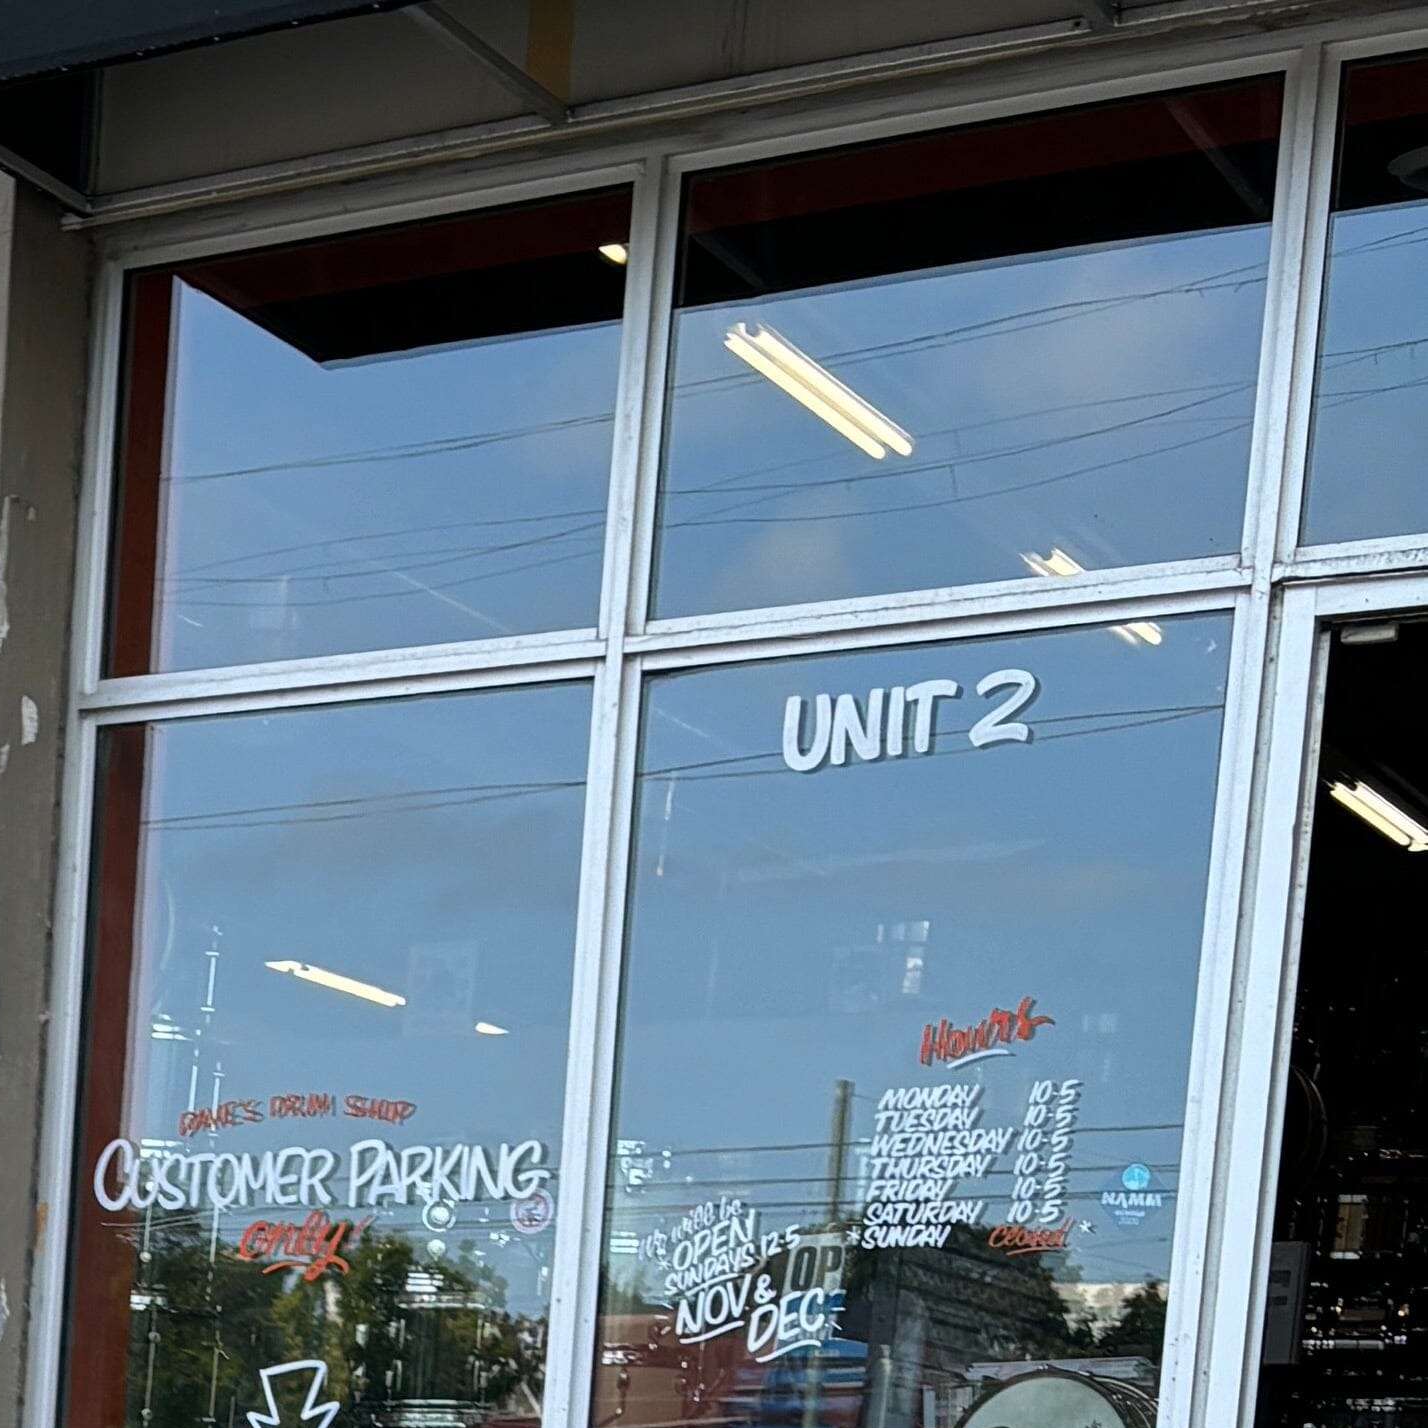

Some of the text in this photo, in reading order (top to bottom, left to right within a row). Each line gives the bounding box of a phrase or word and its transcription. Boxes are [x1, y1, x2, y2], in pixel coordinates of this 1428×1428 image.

[783, 669, 1036, 771] UNIT 2
[878, 1080, 1082, 1110] MONDAY 10-5
[874, 1105, 1077, 1132] TUESDAY 10-5
[870, 1127, 1074, 1157] WEDNESDAY 10-5
[93, 1138, 552, 1212] CUSTOMER PARKING
[869, 1153, 1070, 1180] THURSDAY 10-5
[865, 1177, 1068, 1202] FRIDAY 10-5
[862, 1200, 1064, 1225] SATURDAY 10-5
[672, 1208, 756, 1271] OPEN
[860, 1226, 952, 1249] SUNDAY
[664, 1243, 755, 1296] SUNDAYS
[754, 1274, 777, 1304] &
